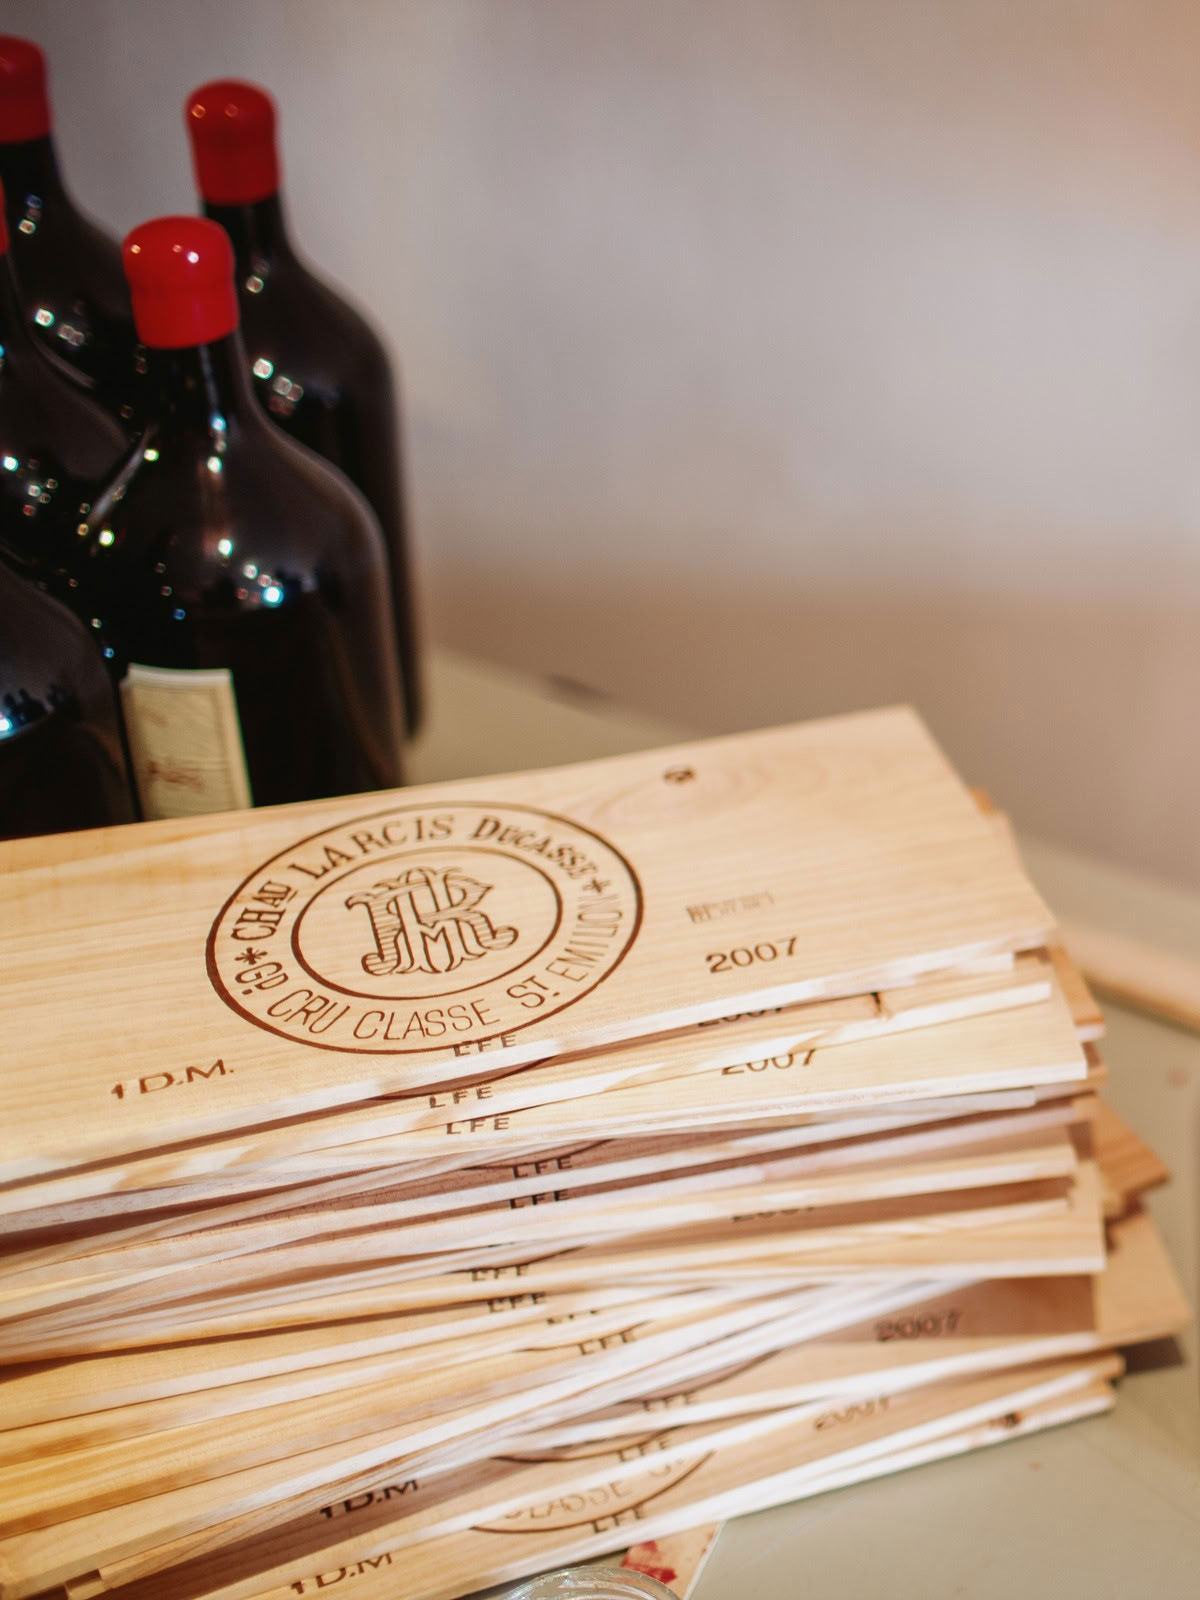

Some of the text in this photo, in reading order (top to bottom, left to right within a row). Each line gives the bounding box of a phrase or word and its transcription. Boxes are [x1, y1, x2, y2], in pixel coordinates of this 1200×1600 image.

[288, 814, 454, 879] LARCIS
[470, 815, 597, 879] DUCASSE
[267, 989, 350, 1034] CRU
[353, 999, 500, 1040] CLASSE
[546, 893, 623, 982] EMILION
[705, 936, 798, 973] 2007
[429, 1086, 493, 1109] LFE
[446, 1117, 510, 1135] LFE
[512, 1154, 573, 1179] LFE
[509, 1188, 569, 1210] LFE
